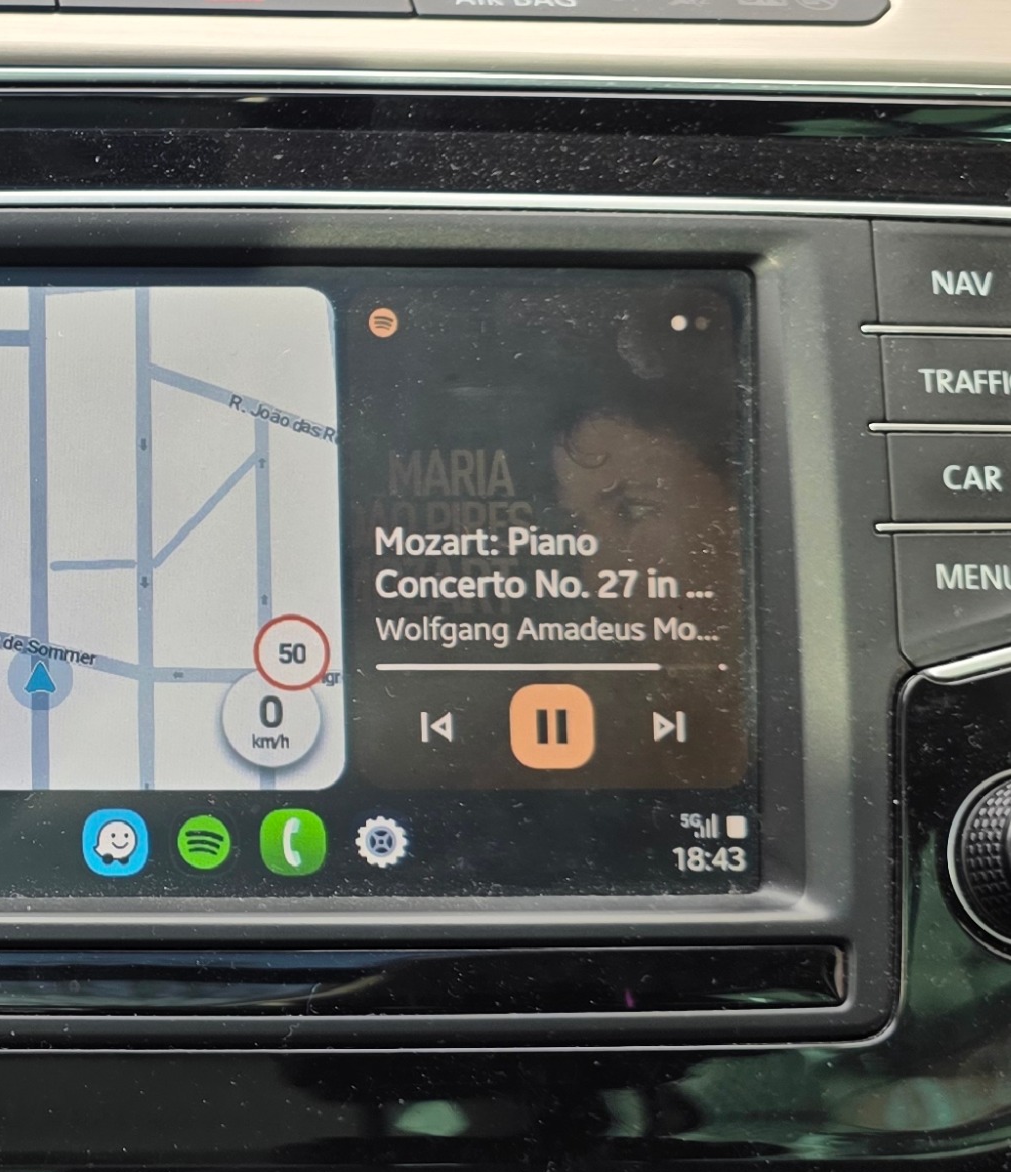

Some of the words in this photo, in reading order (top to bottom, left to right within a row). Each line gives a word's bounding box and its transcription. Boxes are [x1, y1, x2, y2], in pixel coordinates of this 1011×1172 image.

[931, 270, 993, 296] NAV
[918, 368, 1011, 394] TRAFFI
[228, 394, 246, 413] R.
[251, 403, 289, 427] João
[293, 418, 322, 438] das
[389, 448, 516, 497] MARIA
[943, 465, 1003, 492] CAR
[375, 527, 499, 557] Mozart:
[509, 526, 598, 557] Piano
[375, 570, 527, 599] Concerto
[536, 570, 590, 599] No.
[597, 570, 637, 599] 27
[648, 569, 677, 599] in
[375, 617, 509, 648] Wolfgang
[517, 616, 646, 642] Amadeus
[653, 617, 720, 642] Mo...
[3, 635, 23, 651] de
[27, 640, 97, 666] Sommer
[279, 643, 306, 664] 50
[259, 695, 284, 728] 0
[252, 733, 290, 749] km/h
[680, 813, 702, 829] 5G
[672, 846, 748, 872] 18:43
